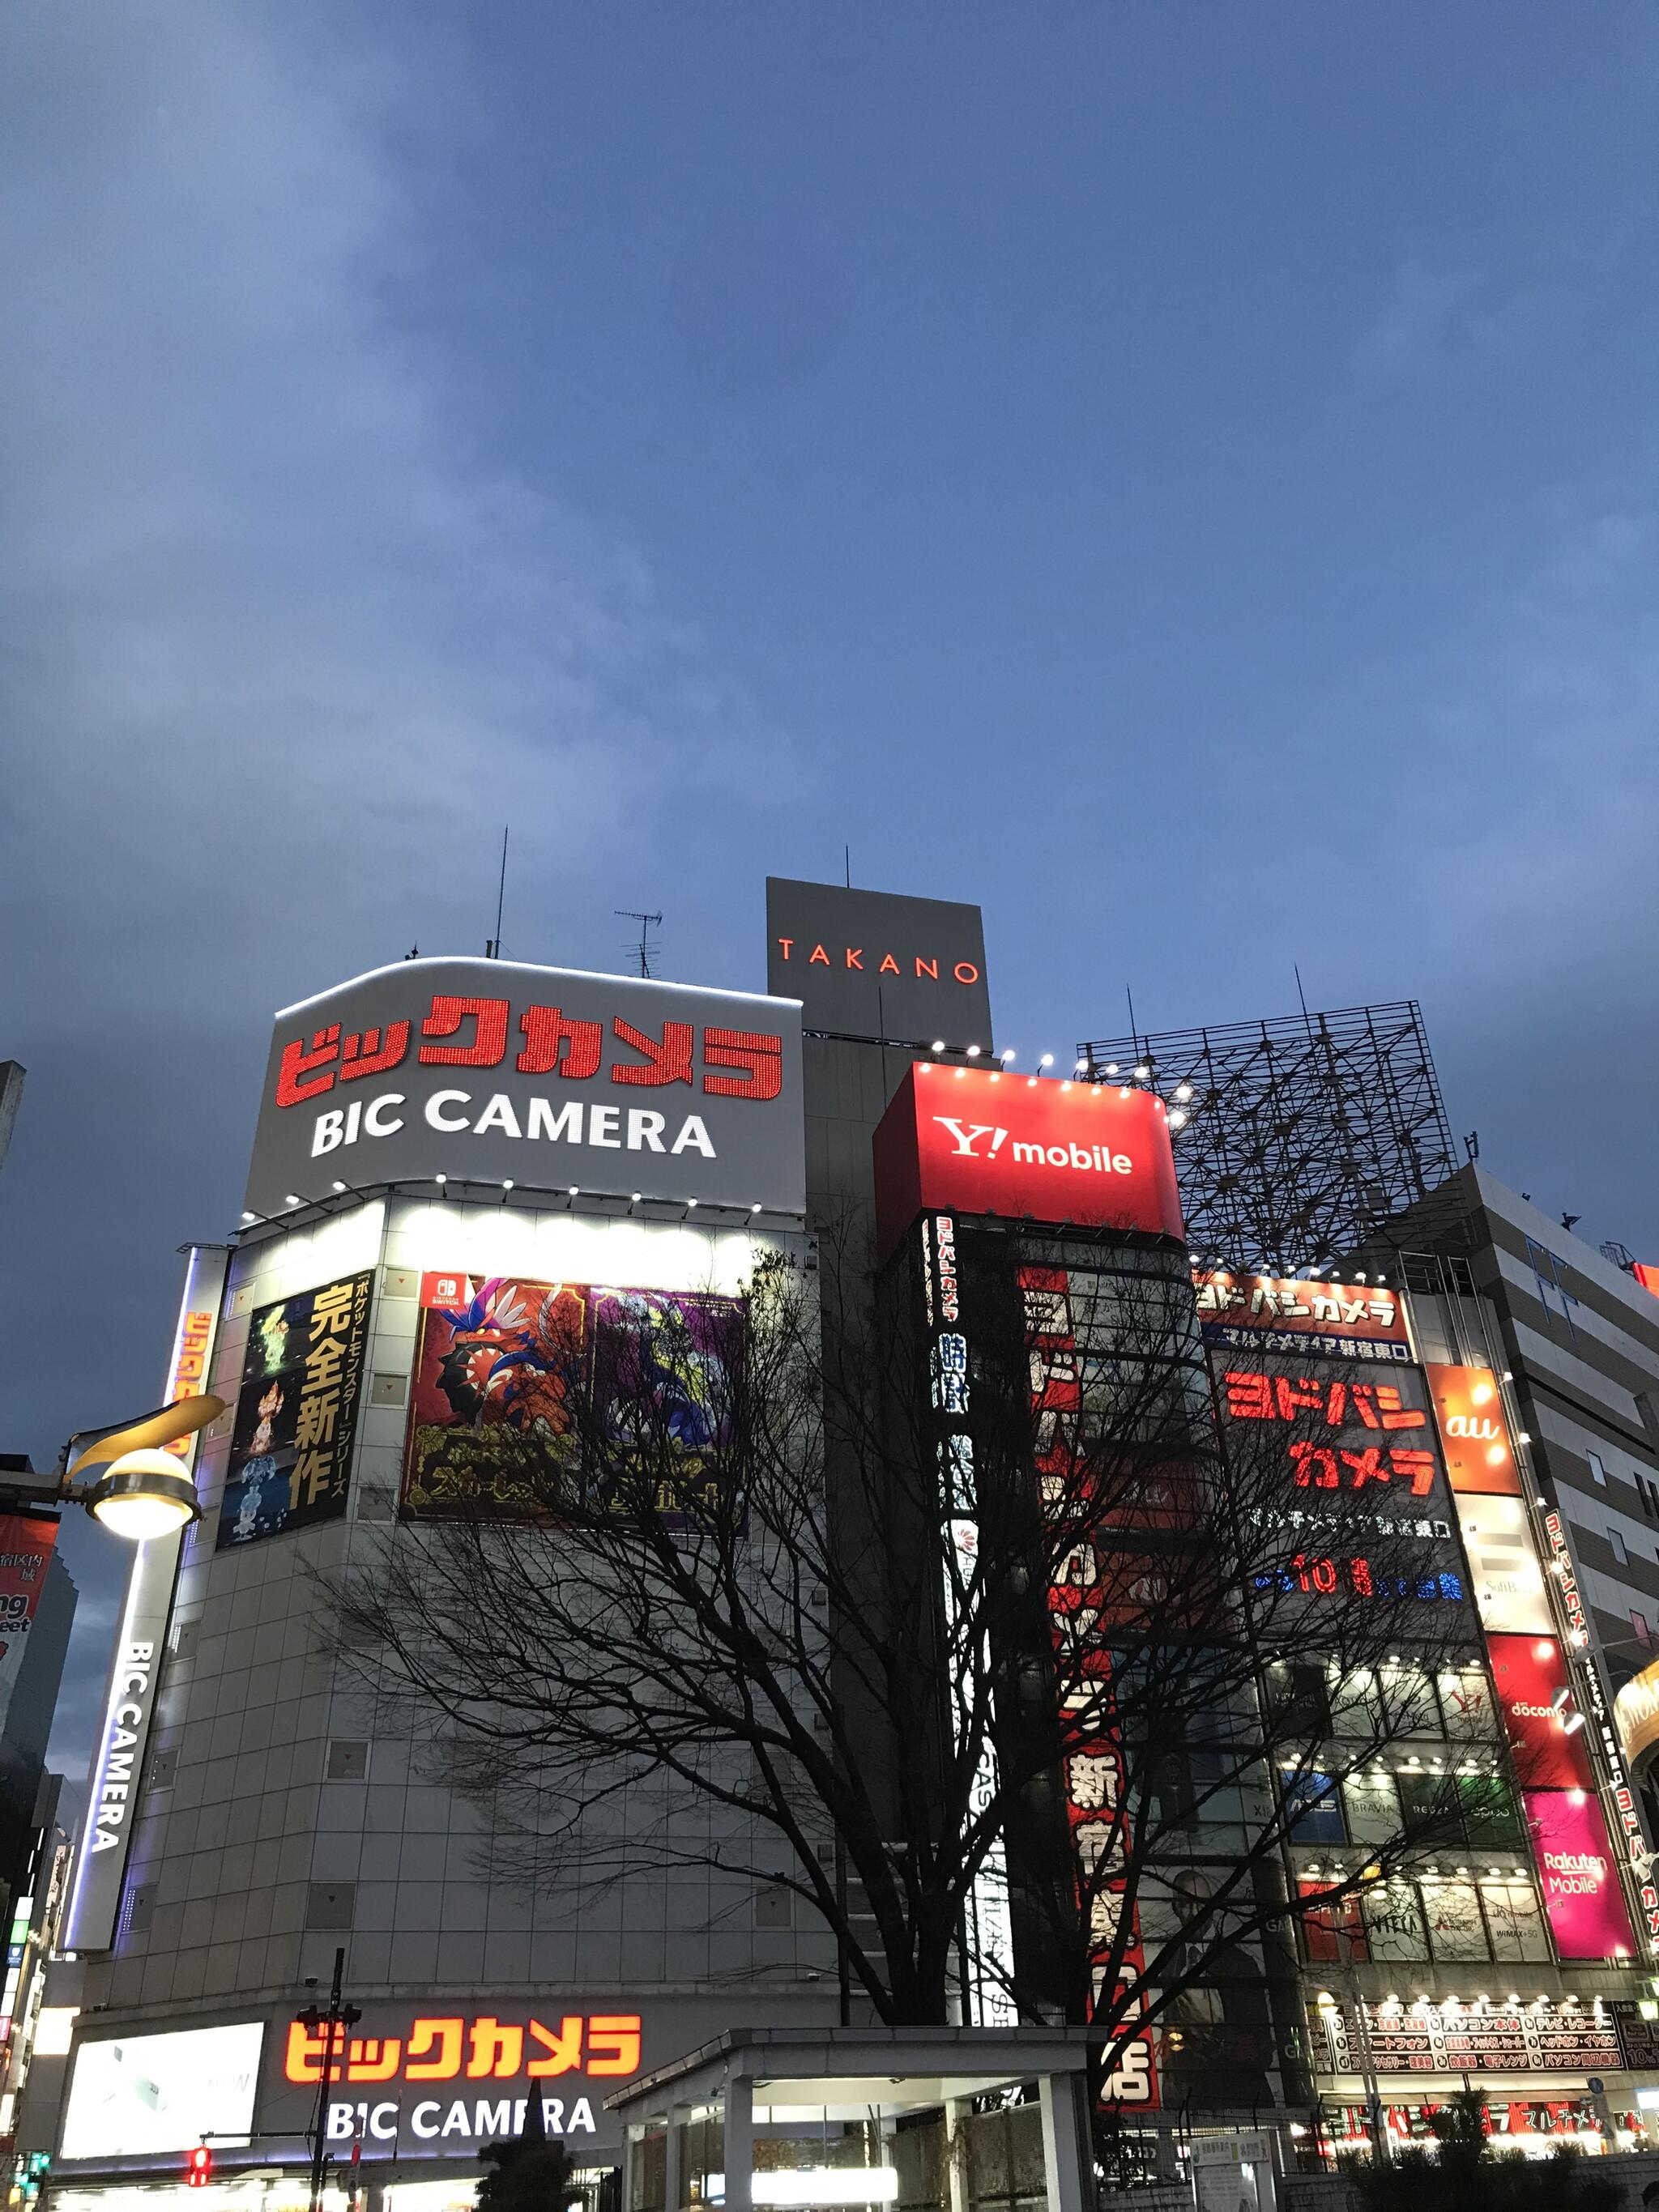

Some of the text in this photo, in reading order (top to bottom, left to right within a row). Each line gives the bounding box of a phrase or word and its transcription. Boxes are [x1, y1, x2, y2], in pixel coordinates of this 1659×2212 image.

[778, 939, 979, 983] TAKANO
[276, 995, 783, 1107] ビックカメラ
[311, 1089, 717, 1158] BIC CAMERA
[1013, 1140, 1133, 1175] mobile
[936, 1216, 958, 1322] ヨドバシカメラ
[1196, 1282, 1397, 1328] ヨドバシカメラ
[289, 1283, 353, 1511] 完全新作
[1224, 1371, 1427, 1430] ヨドバシ
[1446, 1416, 1499, 1439] au
[1289, 1440, 1435, 1496] カメラ
[92, 1641, 154, 1853] BIC CAMERA
[1352, 1802, 1393, 1813] BRAVIA
[1544, 1852, 1607, 1872] Rakuten
[1550, 1877, 1598, 1895] Mobile
[285, 2014, 642, 2084] ビックカメラ
[326, 2101, 399, 2139] BIC
